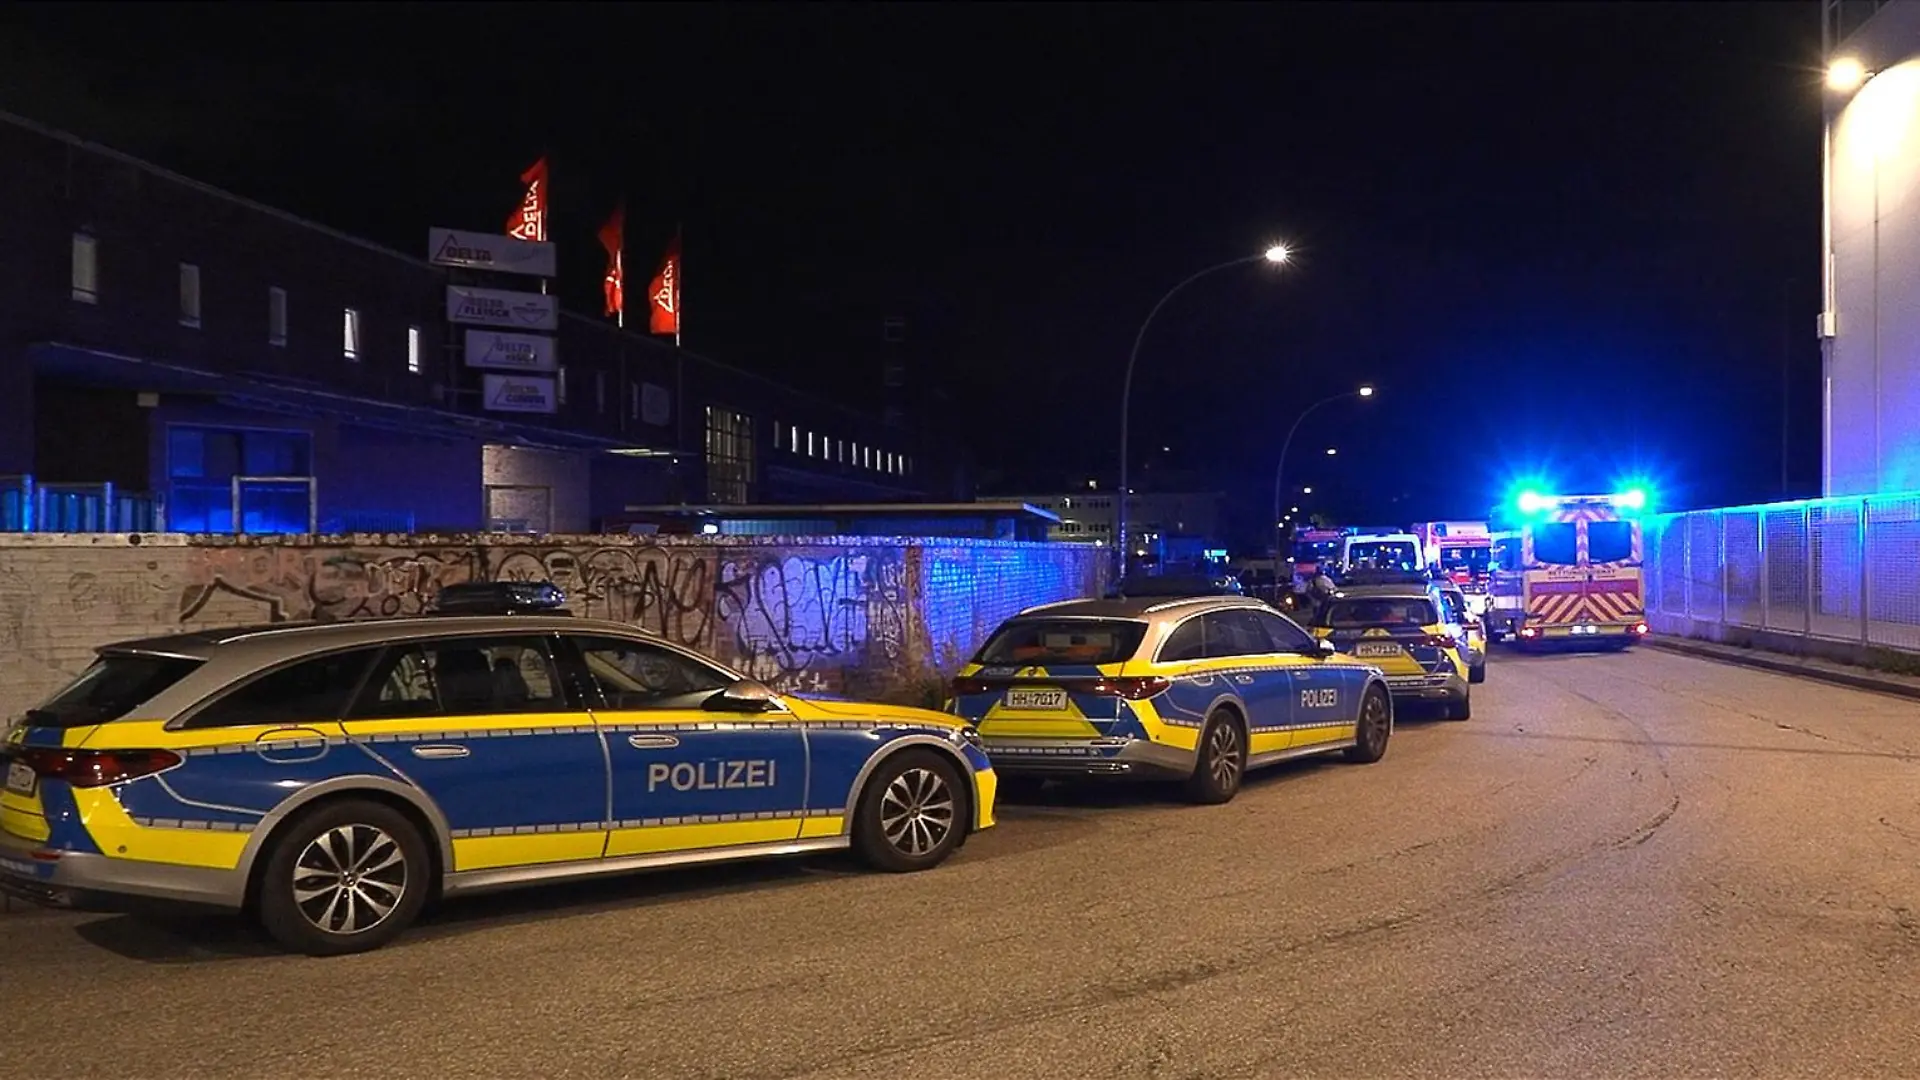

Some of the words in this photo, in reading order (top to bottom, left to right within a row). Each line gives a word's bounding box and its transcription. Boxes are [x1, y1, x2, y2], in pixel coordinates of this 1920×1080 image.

[446, 246, 493, 261] DELTA
[1301, 689, 1337, 708] POLIZEI
[648, 760, 775, 792] POLIZEI
